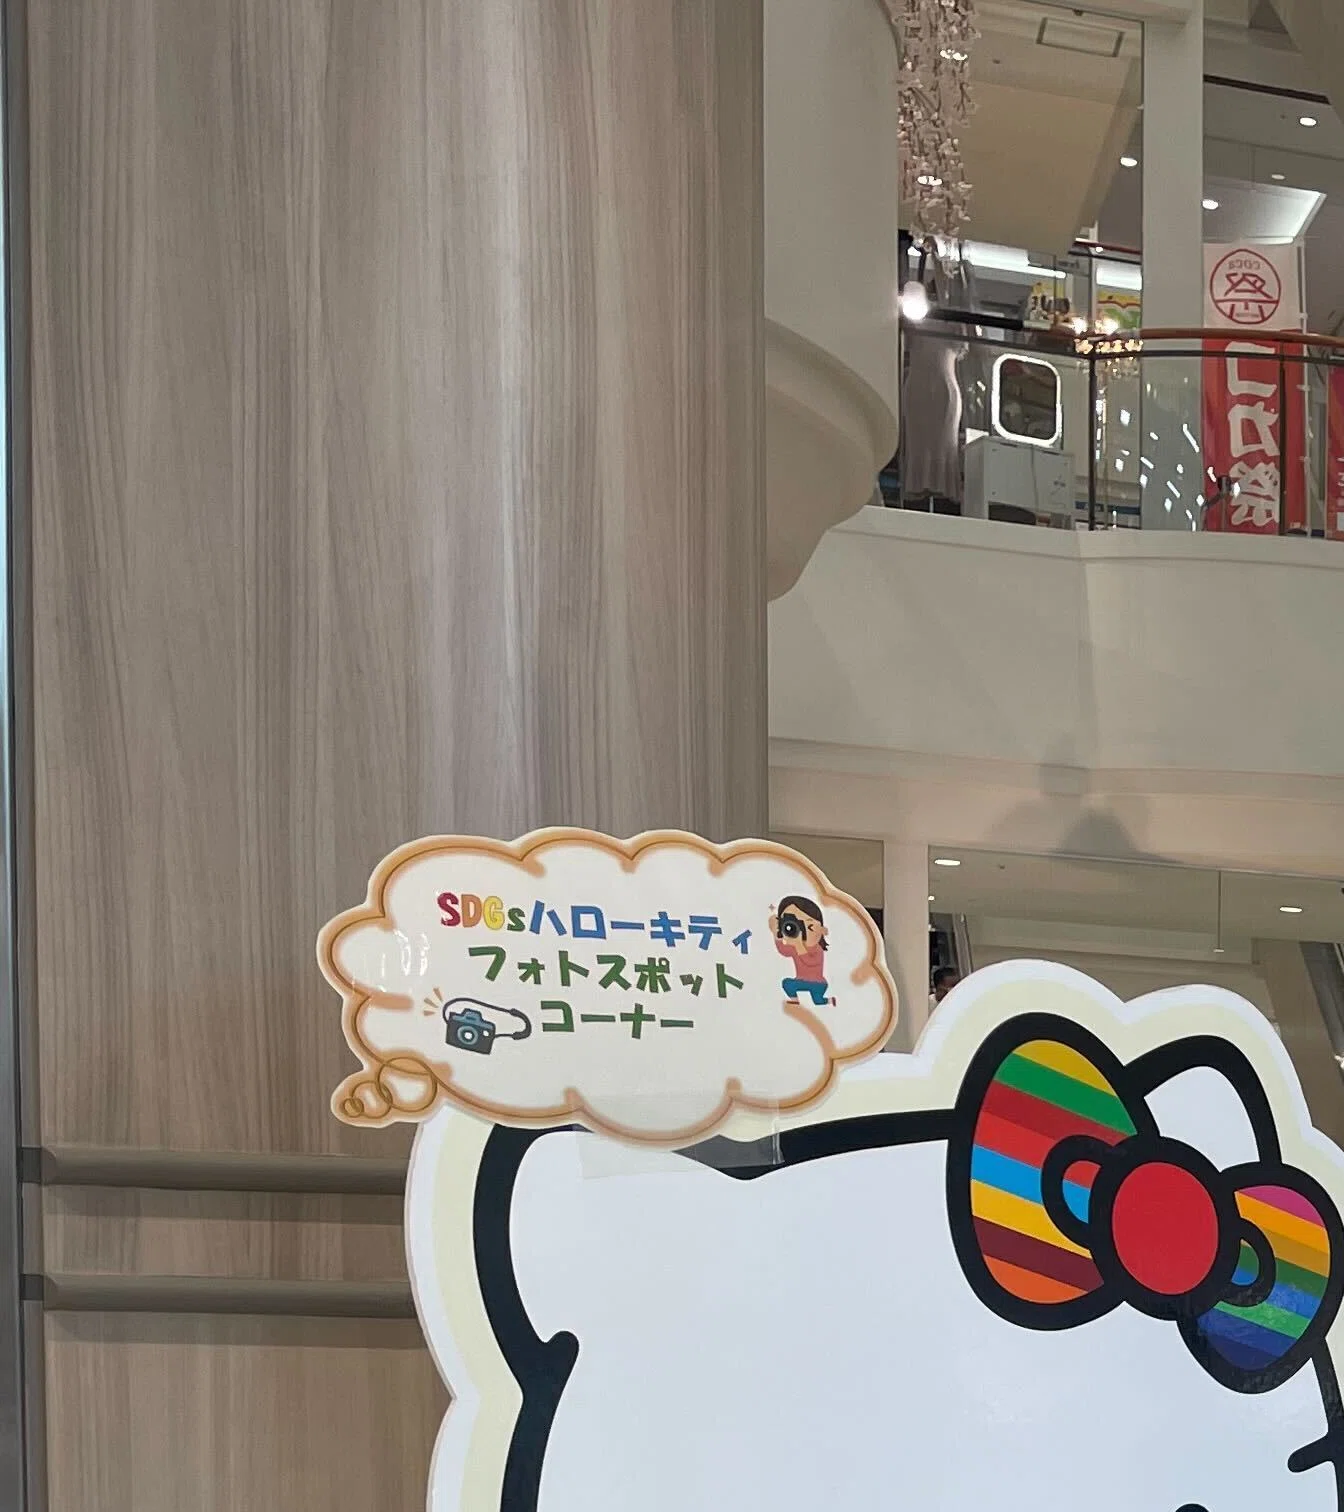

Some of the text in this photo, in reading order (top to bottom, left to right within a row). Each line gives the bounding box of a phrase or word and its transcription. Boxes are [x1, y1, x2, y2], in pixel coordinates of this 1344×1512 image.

[436, 892, 753, 956] SDGsハローキティ
[468, 945, 744, 998] フォトスポット
[540, 1000, 695, 1040] コーナー
